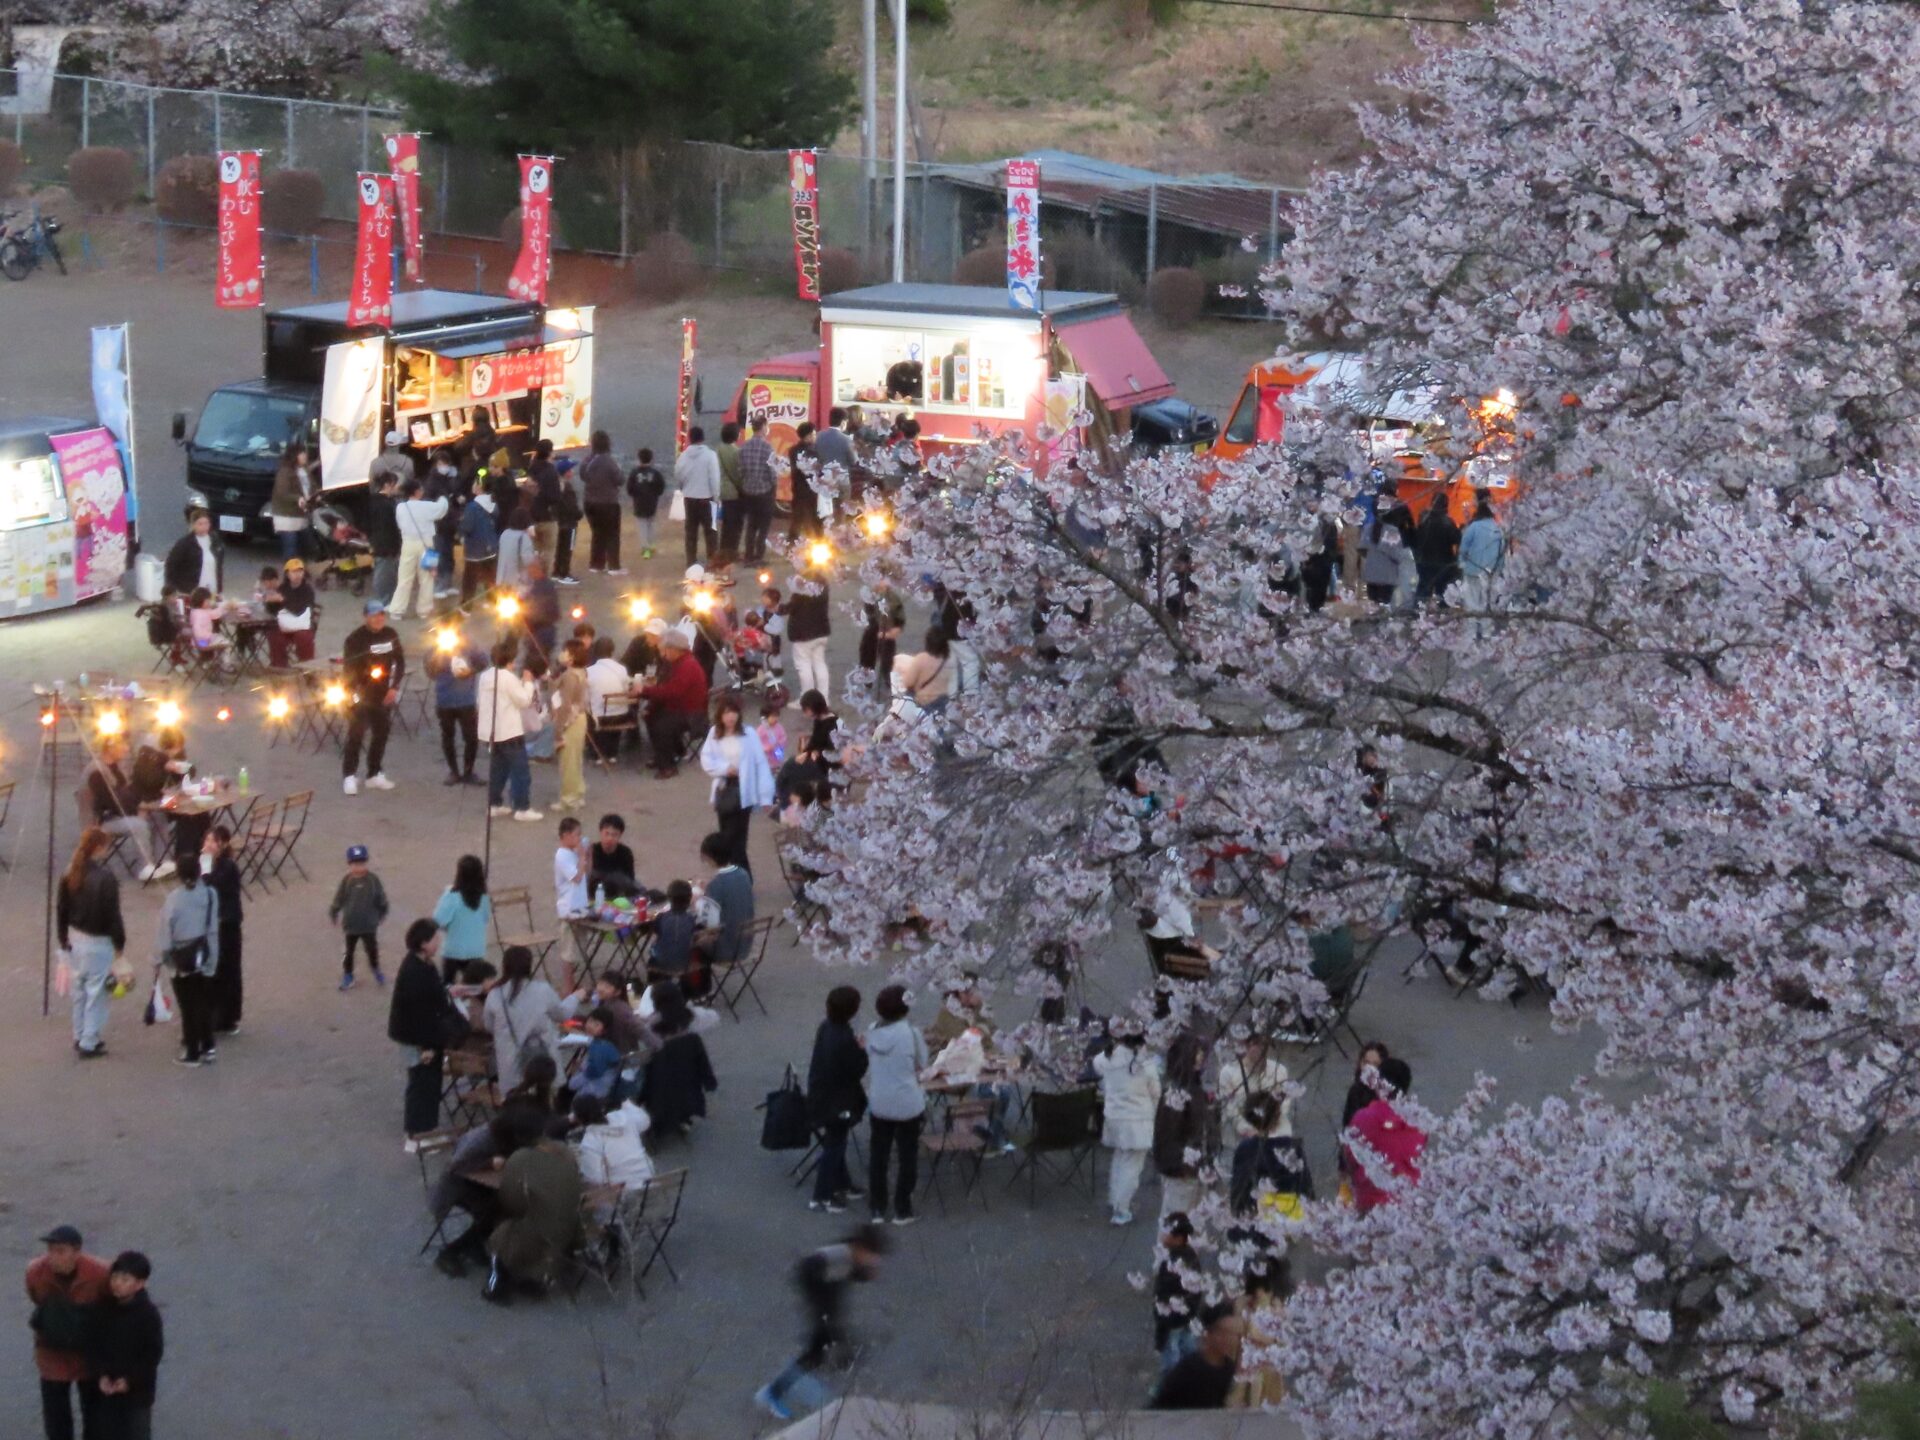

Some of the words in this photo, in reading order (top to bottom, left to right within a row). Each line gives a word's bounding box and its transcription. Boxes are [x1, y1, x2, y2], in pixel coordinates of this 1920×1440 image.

[237, 178, 253, 215] 飲む
[374, 202, 389, 237] 飲む
[221, 194, 236, 283] わらびもち
